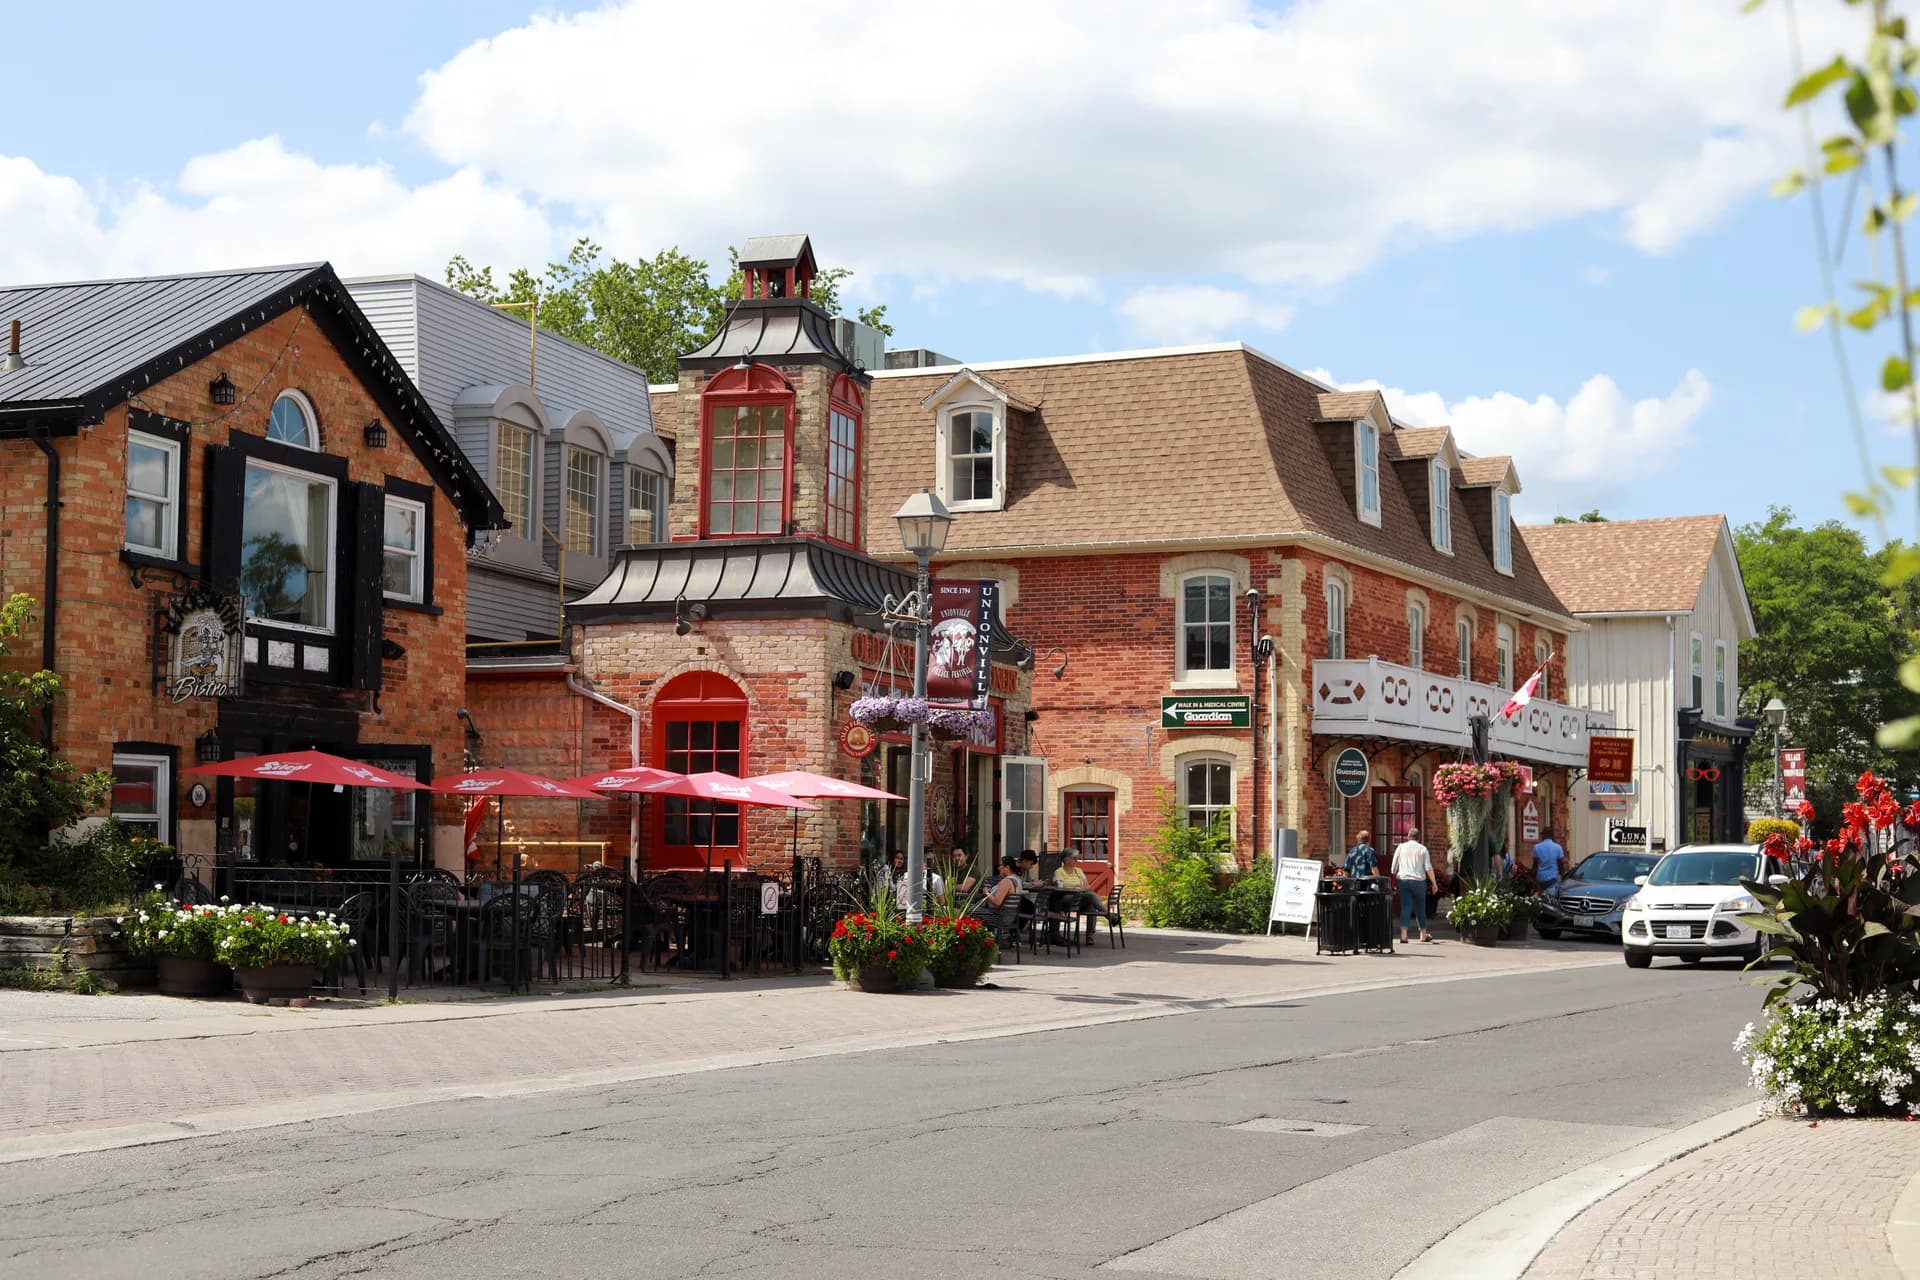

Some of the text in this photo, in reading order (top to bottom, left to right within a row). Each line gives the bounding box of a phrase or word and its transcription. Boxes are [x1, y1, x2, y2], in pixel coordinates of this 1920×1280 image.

[852, 632, 880, 664] OLD
[977, 587, 992, 702] UNIONVILLE
[172, 676, 227, 704] Bistro
[1184, 712, 1232, 721] Guardian
[1336, 768, 1366, 777] Guardian
[1622, 832, 1646, 840] LUNA
